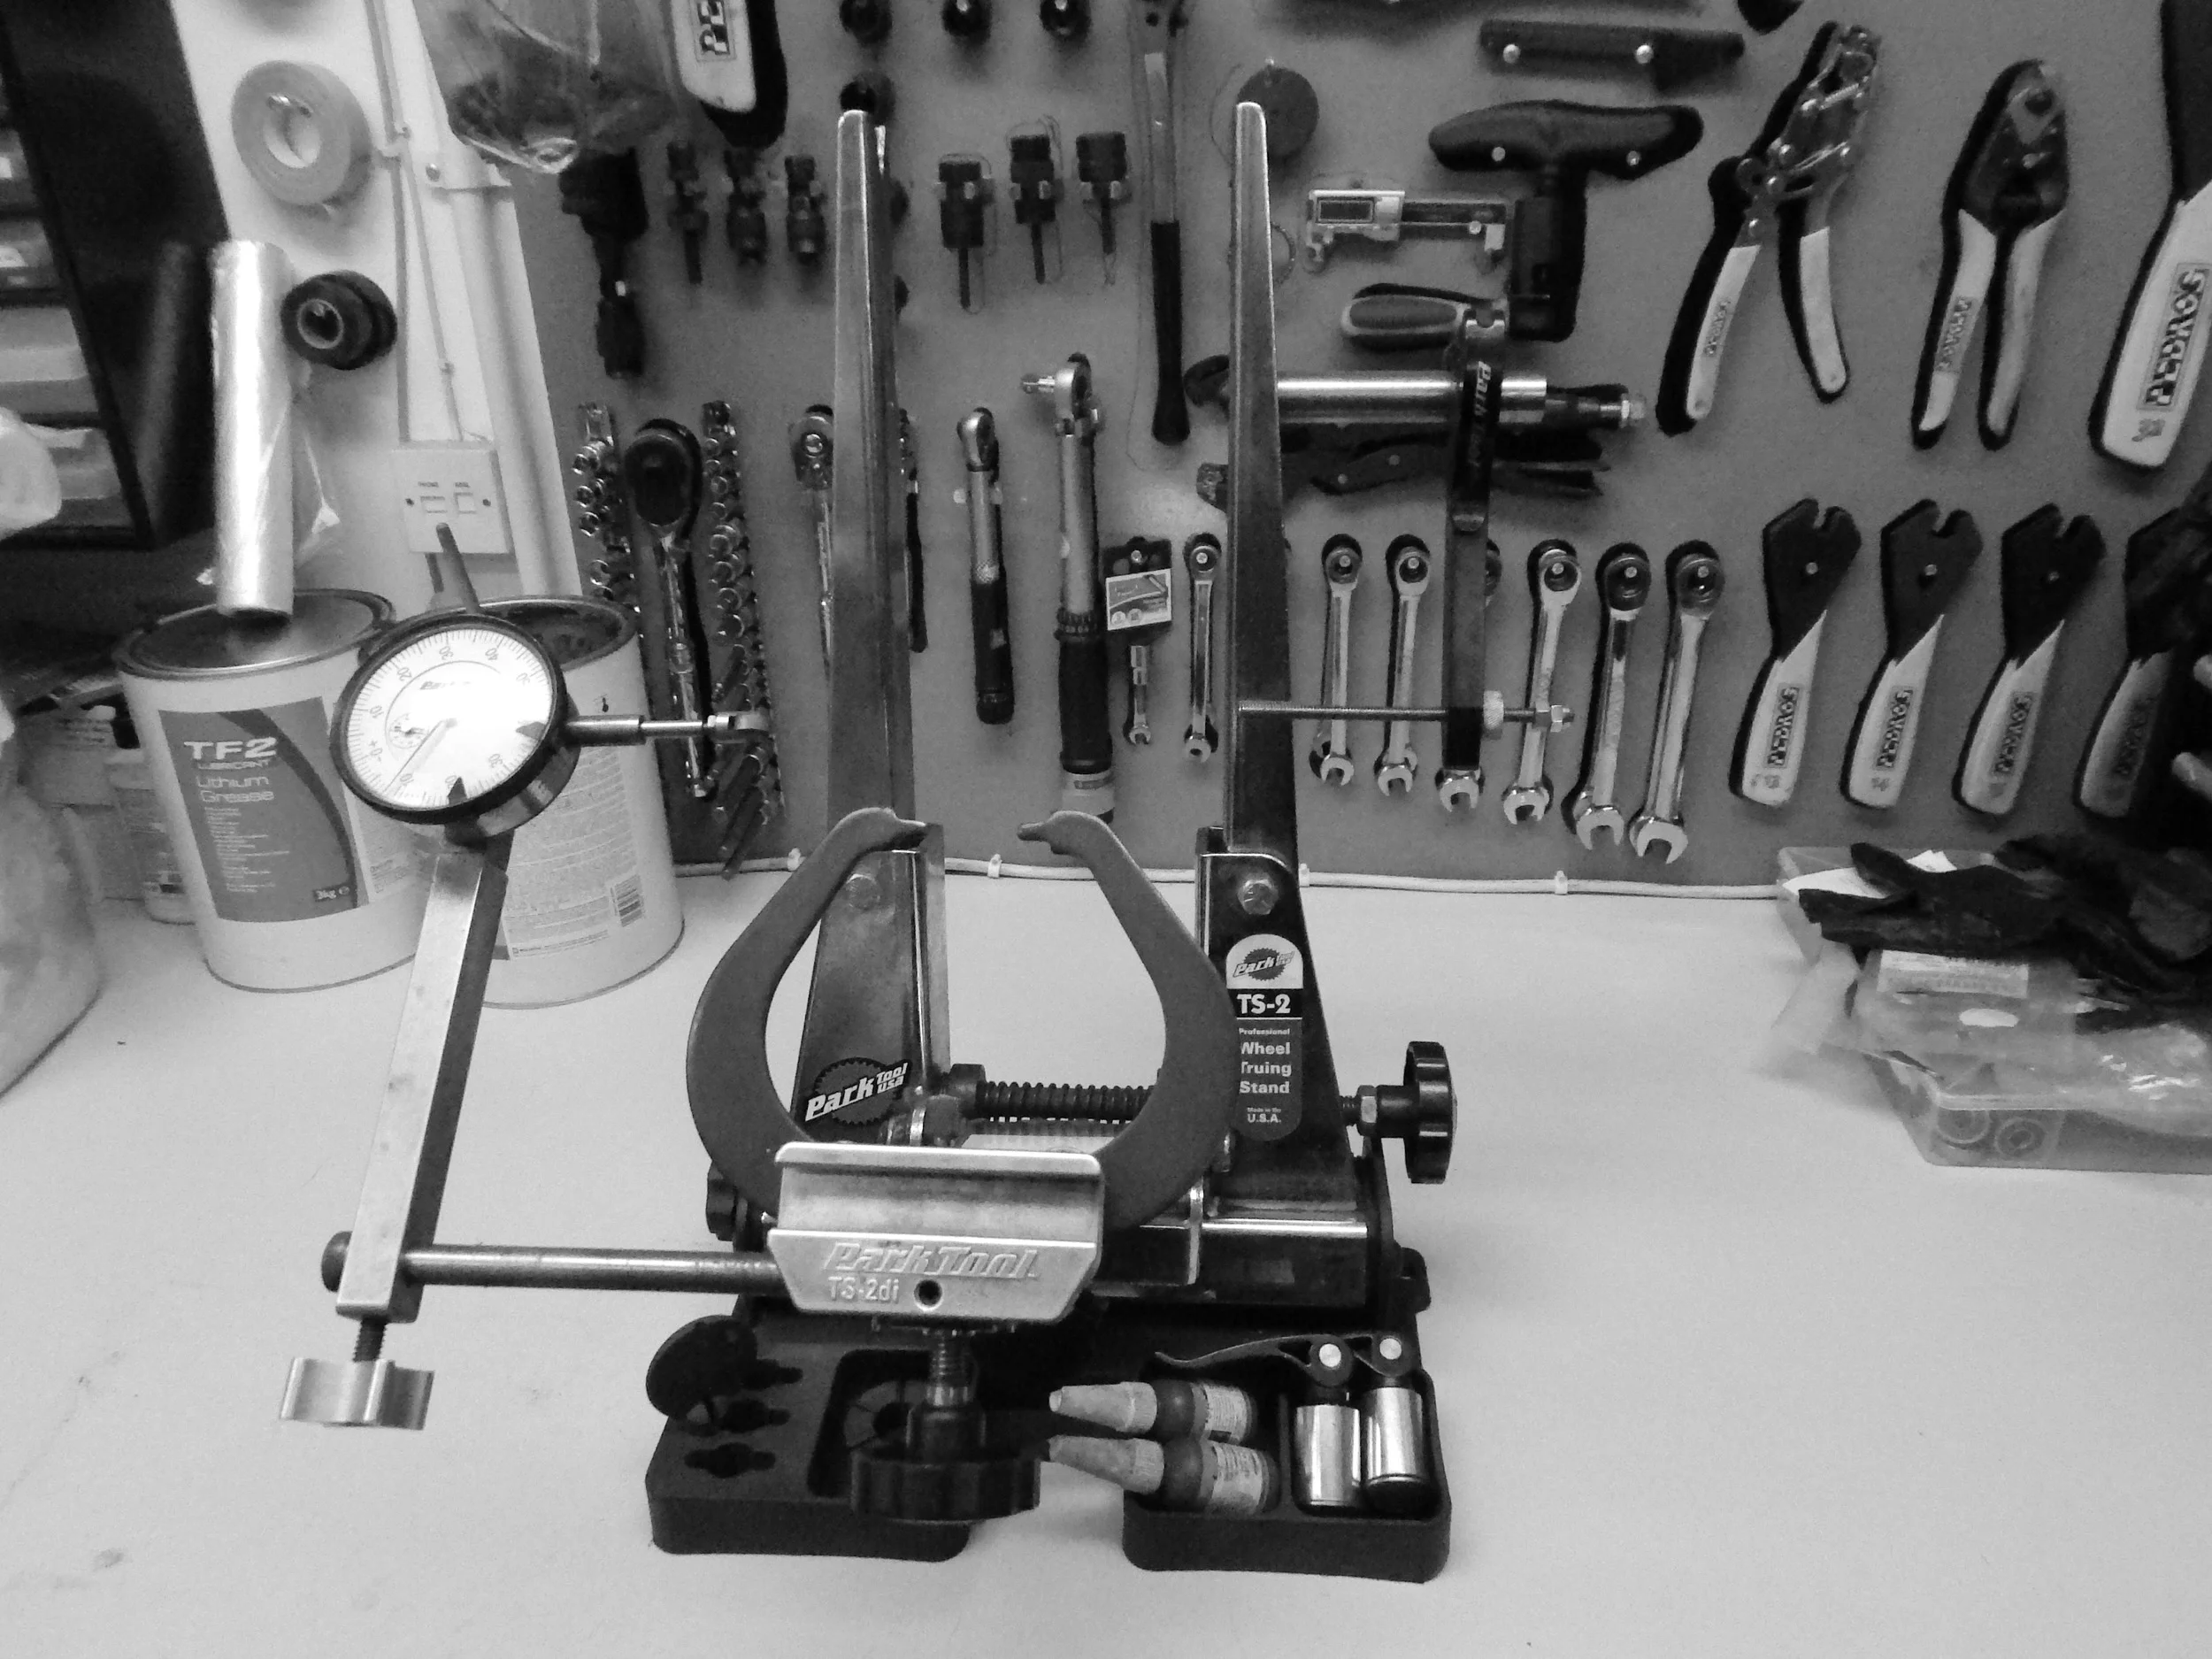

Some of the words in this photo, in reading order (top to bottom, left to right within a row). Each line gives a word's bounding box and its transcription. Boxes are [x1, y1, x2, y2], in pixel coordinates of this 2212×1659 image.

[2145, 268, 2208, 407] PEDROS
[1766, 687, 1801, 766] PEDROS
[1877, 689, 1914, 768] PEDROS
[1995, 694, 2033, 774] PEDROS
[183, 736, 277, 760] TF2
[196, 776, 270, 788] Lithium
[200, 789, 275, 803] Grease
[1233, 956, 1275, 978] Park
[1236, 993, 1291, 1015] TS-2
[1239, 1027, 1291, 1036] Professional
[1240, 1041, 1291, 1056] Wheel
[1240, 1061, 1292, 1077] Truing
[804, 1077, 874, 1122] Park
[876, 1062, 909, 1085] Tool
[1239, 1080, 1291, 1094] Stand
[1247, 1113, 1282, 1124] U.S.A.
[827, 1275, 900, 1303] TS-2di
